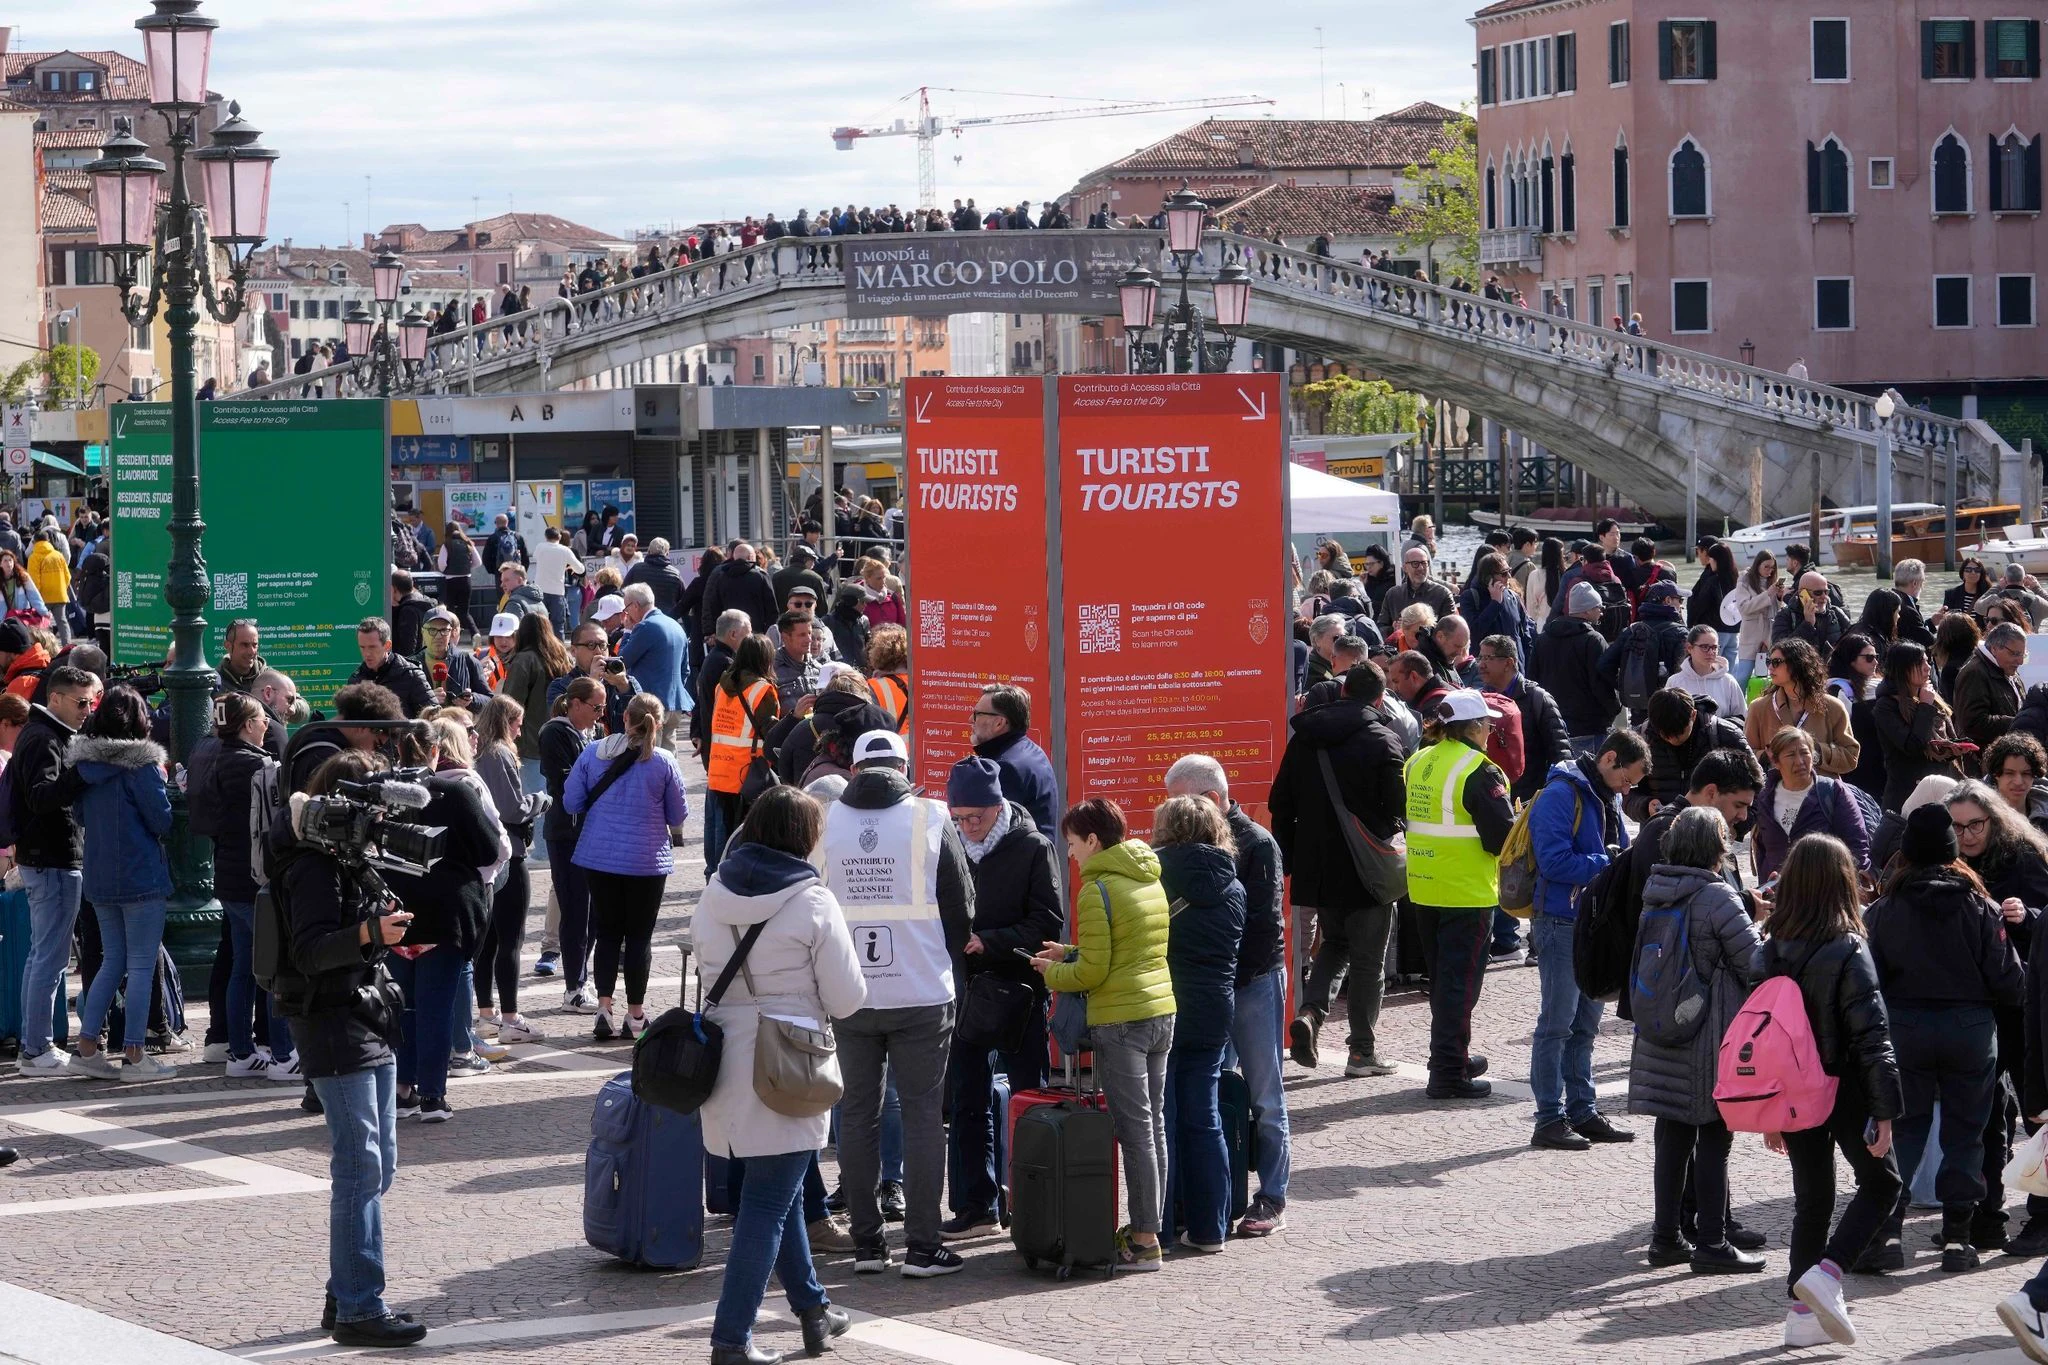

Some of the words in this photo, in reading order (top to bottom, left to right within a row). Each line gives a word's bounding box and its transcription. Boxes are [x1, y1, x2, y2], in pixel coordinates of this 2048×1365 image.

[918, 249, 930, 261] di
[855, 260, 983, 290] MARCO
[990, 259, 1078, 286] POLO
[867, 293, 900, 306] viaggio
[902, 292, 912, 302] di
[914, 293, 926, 302] un
[928, 291, 972, 301] mercante
[973, 290, 1017, 299] veneziano
[1018, 289, 1033, 299] del
[1035, 289, 1078, 299] Duecento
[946, 384, 972, 394] Contributo
[980, 385, 1002, 394] Accesso
[1073, 383, 1120, 393] Contributo
[1121, 382, 1128, 392] di
[1130, 383, 1164, 392] Accesso
[1166, 382, 1180, 392] alla
[1181, 382, 1201, 392] Città
[946, 398, 964, 408] Access
[1073, 398, 1104, 407] Access
[1106, 398, 1122, 406] Fee
[1124, 398, 1132, 406] to
[1133, 397, 1146, 406] the
[1147, 396, 1168, 408] City
[212, 406, 250, 414] Contributo
[510, 405, 524, 422] A
[542, 404, 554, 420] B
[274, 416, 290, 424] City
[116, 455, 150, 467] RESIDENTI,
[150, 455, 173, 466] STUDEN
[916, 448, 998, 475] TURISTI
[1076, 446, 1210, 476] TURISTI
[118, 470, 122, 480] E
[122, 470, 158, 480] LAVORATORI
[1327, 463, 1373, 475] Ferrovia
[117, 492, 151, 505] RESIDENTS,
[152, 492, 173, 504] STUDE
[451, 492, 487, 502] GREEN
[919, 483, 1018, 511] TOURISTS
[1080, 480, 1240, 511] TOURISTS
[117, 507, 130, 518] AND
[132, 508, 160, 518] WORKERS
[258, 572, 286, 580] Inquadra
[1132, 603, 1166, 612] Inquadra
[1174, 602, 1184, 610] QR
[1186, 601, 1205, 610] code
[1132, 615, 1144, 624] per
[1146, 614, 1176, 622] saperne
[1177, 613, 1184, 622] di
[1186, 613, 1198, 622] più
[1132, 630, 1150, 638] Scan
[1151, 629, 1163, 638] the
[1164, 628, 1174, 637] QR
[1176, 628, 1194, 636] code
[1140, 640, 1158, 648] learn
[1160, 640, 1178, 648] more
[1087, 674, 1124, 683] contributo
[1131, 673, 1155, 682] dovuto
[1156, 672, 1173, 680] dalle
[1191, 670, 1203, 679] alle
[1226, 668, 1262, 677] solamente
[1080, 686, 1092, 694] nei
[1092, 684, 1112, 694] giorni
[1114, 684, 1139, 692] indicati
[1140, 682, 1156, 691] nella
[1158, 682, 1180, 690] tabella
[1182, 680, 1223, 688] sottostante.
[1088, 736, 1110, 744] Aprile
[1147, 732, 1160, 742] 25,
[1160, 732, 1173, 740] 26,
[1174, 731, 1185, 740] 27,
[1186, 730, 1198, 740] 28,
[1212, 729, 1223, 738] 30
[1088, 756, 1116, 766] Maggio
[1250, 748, 1260, 756] 26
[1090, 778, 1116, 786] Giugno
[1229, 770, 1239, 778] 30
[842, 858, 895, 866] CONTRIBUTO
[846, 868, 854, 876] DI
[856, 868, 892, 876] ACCESSO
[848, 885, 877, 893] ACCESS
